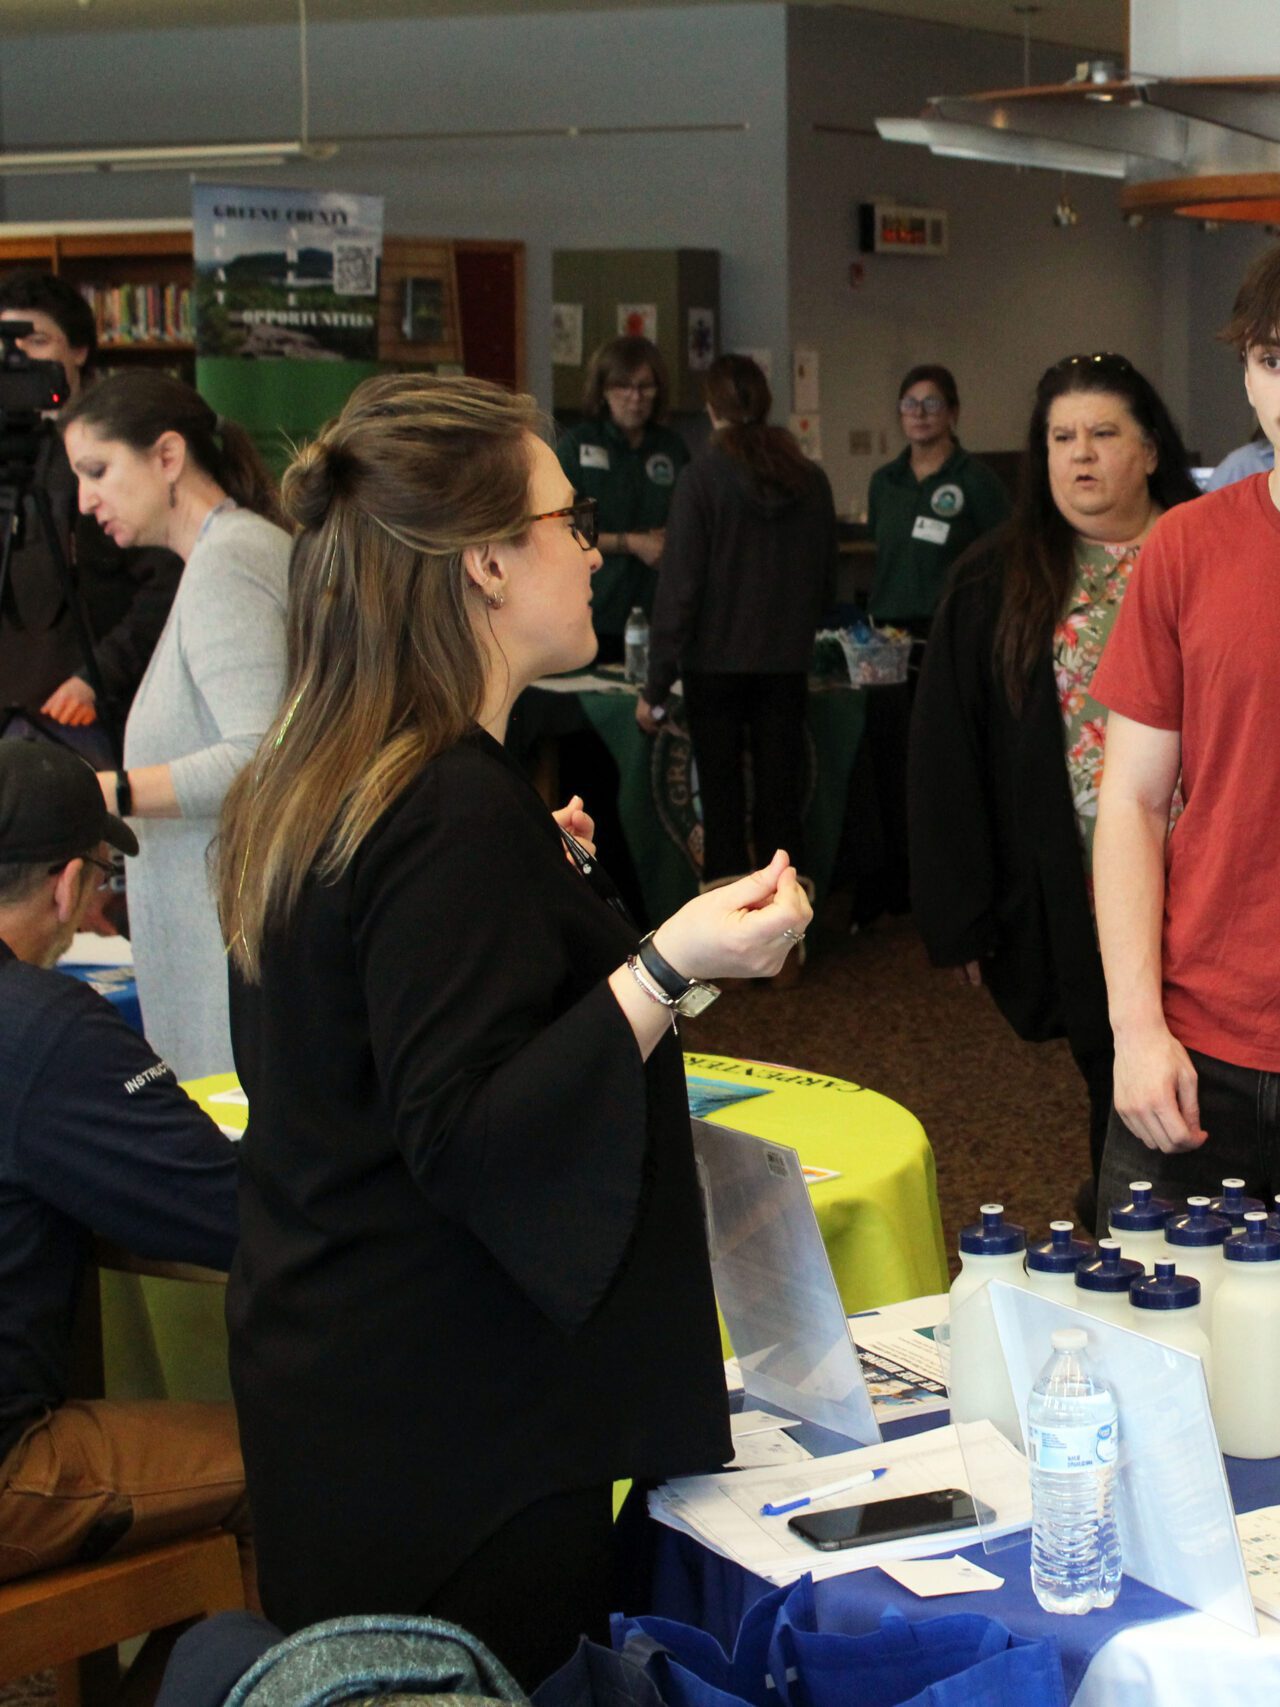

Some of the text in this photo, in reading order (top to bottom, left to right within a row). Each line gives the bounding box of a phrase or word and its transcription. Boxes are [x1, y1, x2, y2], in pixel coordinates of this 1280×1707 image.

[285, 208, 349, 225] COUNTY
[242, 310, 375, 327] OPPORTUNITIES
[684, 1055, 866, 1093] CARPENTER
